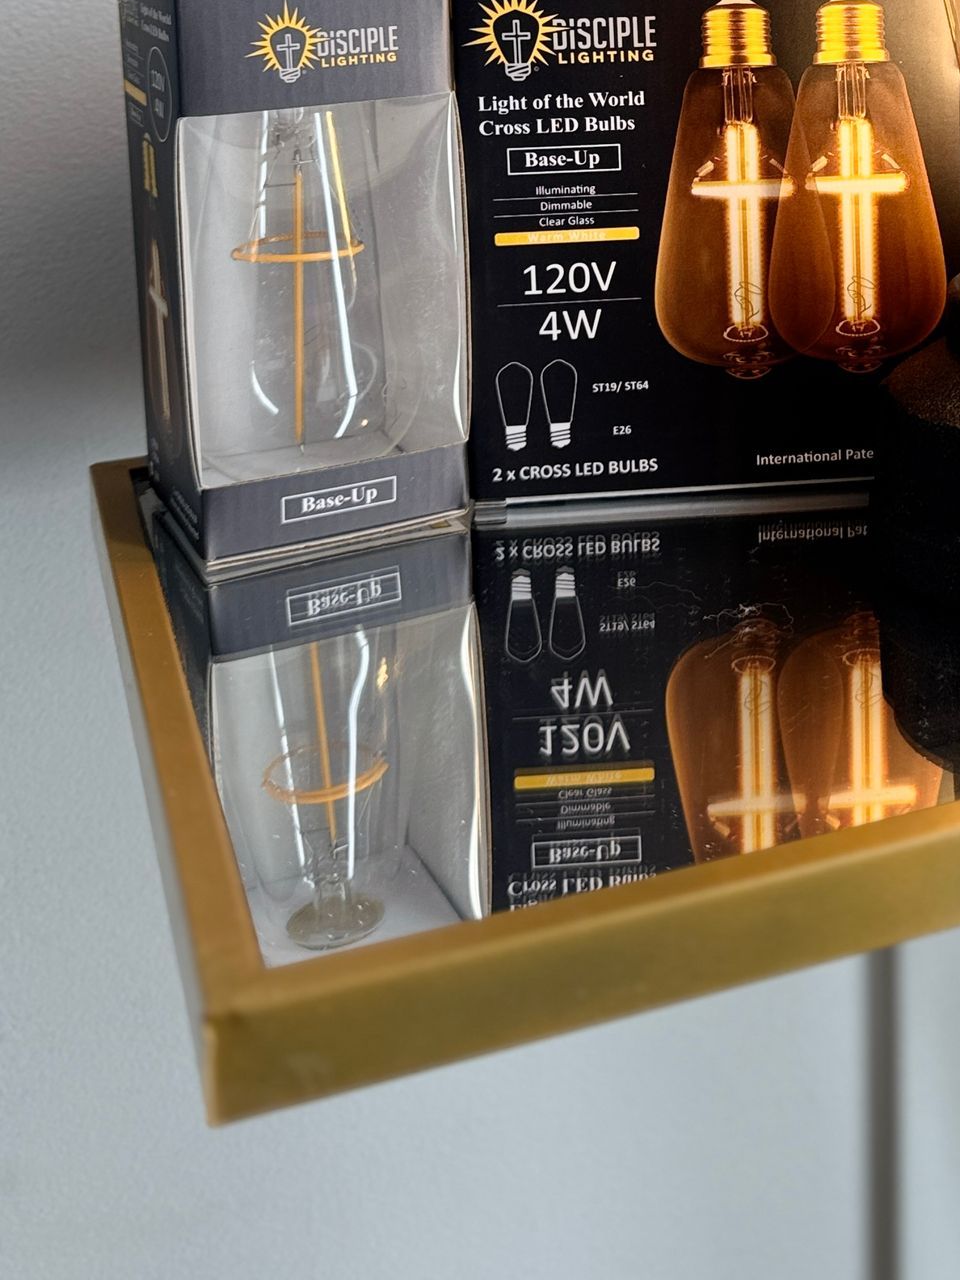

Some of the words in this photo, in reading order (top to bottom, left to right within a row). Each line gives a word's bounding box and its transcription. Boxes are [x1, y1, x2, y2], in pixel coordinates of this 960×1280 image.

[321, 52, 398, 69] LIGHTING
[557, 49, 656, 66] LIGHTING
[478, 94, 529, 115] Light
[532, 93, 553, 110] of
[555, 93, 585, 110] the
[588, 90, 646, 109] World
[478, 120, 531, 137] Cross
[536, 118, 580, 135] LED
[584, 115, 637, 133] Bulbs
[524, 149, 601, 169] Base-Up
[535, 184, 597, 197] Illuminating
[540, 199, 594, 212] Dimmable
[538, 216, 566, 228] Clear
[567, 215, 596, 226] Glass
[527, 231, 565, 244] Warm
[568, 229, 608, 242] White
[522, 260, 618, 297] 120V
[538, 307, 603, 342] 4W
[591, 381, 623, 394] ST19/
[624, 379, 650, 393] ST64
[612, 425, 633, 437] E26
[756, 448, 843, 467] International
[492, 467, 504, 483] 2
[506, 468, 517, 482] x
[519, 463, 572, 481] CROSS
[574, 461, 605, 477] LED
[608, 457, 660, 475] BULBS
[300, 486, 379, 514] Base-Up
